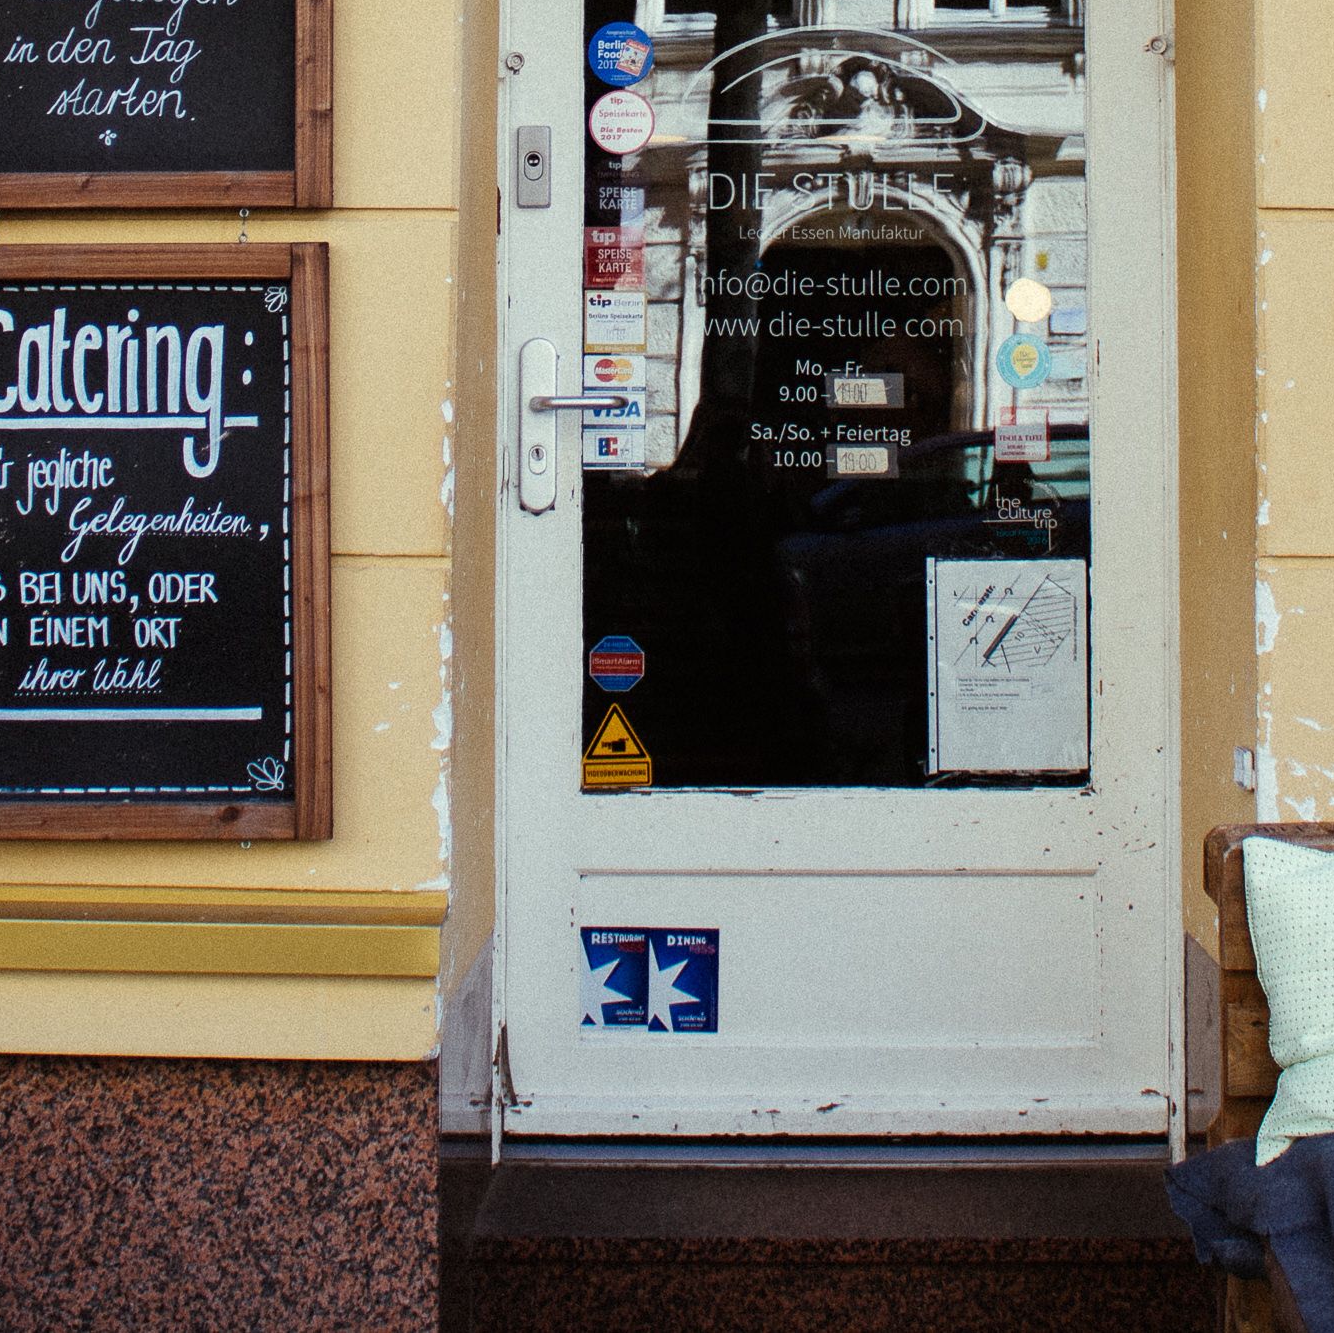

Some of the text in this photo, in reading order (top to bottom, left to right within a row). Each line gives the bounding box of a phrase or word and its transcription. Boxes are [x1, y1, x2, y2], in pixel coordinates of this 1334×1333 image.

[4, 26, 202, 83] in den Tag
[47, 78, 197, 122] starten.
[599, 187, 637, 198] SPEISE
[709, 172, 776, 211] DIE
[599, 199, 637, 209] KARTE
[739, 225, 925, 240] Lecer Essen Manufaktur
[598, 249, 632, 259] SPEISE
[598, 263, 632, 273] KARTE
[701, 268, 967, 300] nfo@die-stulle.com
[589, 294, 612, 308] tip
[796, 360, 828, 377] Mo.
[845, 361, 866, 378] Fr.
[779, 386, 817, 402] 9.00
[750, 423, 815, 443] Sa./So.
[837, 424, 912, 446] Feiertag
[773, 451, 822, 467] 10.00
[16, 448, 115, 516] jegliche
[997, 507, 1052, 520] culture
[19, 571, 62, 605] BEI
[72, 570, 139, 613] UNS,
[148, 572, 219, 605] ODER
[962, 584, 996, 627] Carerstr.
[29, 616, 109, 648] EINEM
[134, 616, 182, 648] ORT
[18, 658, 161, 692] ihrer Wahl
[591, 932, 645, 945] RESTAURANT
[667, 934, 707, 947] DINING
